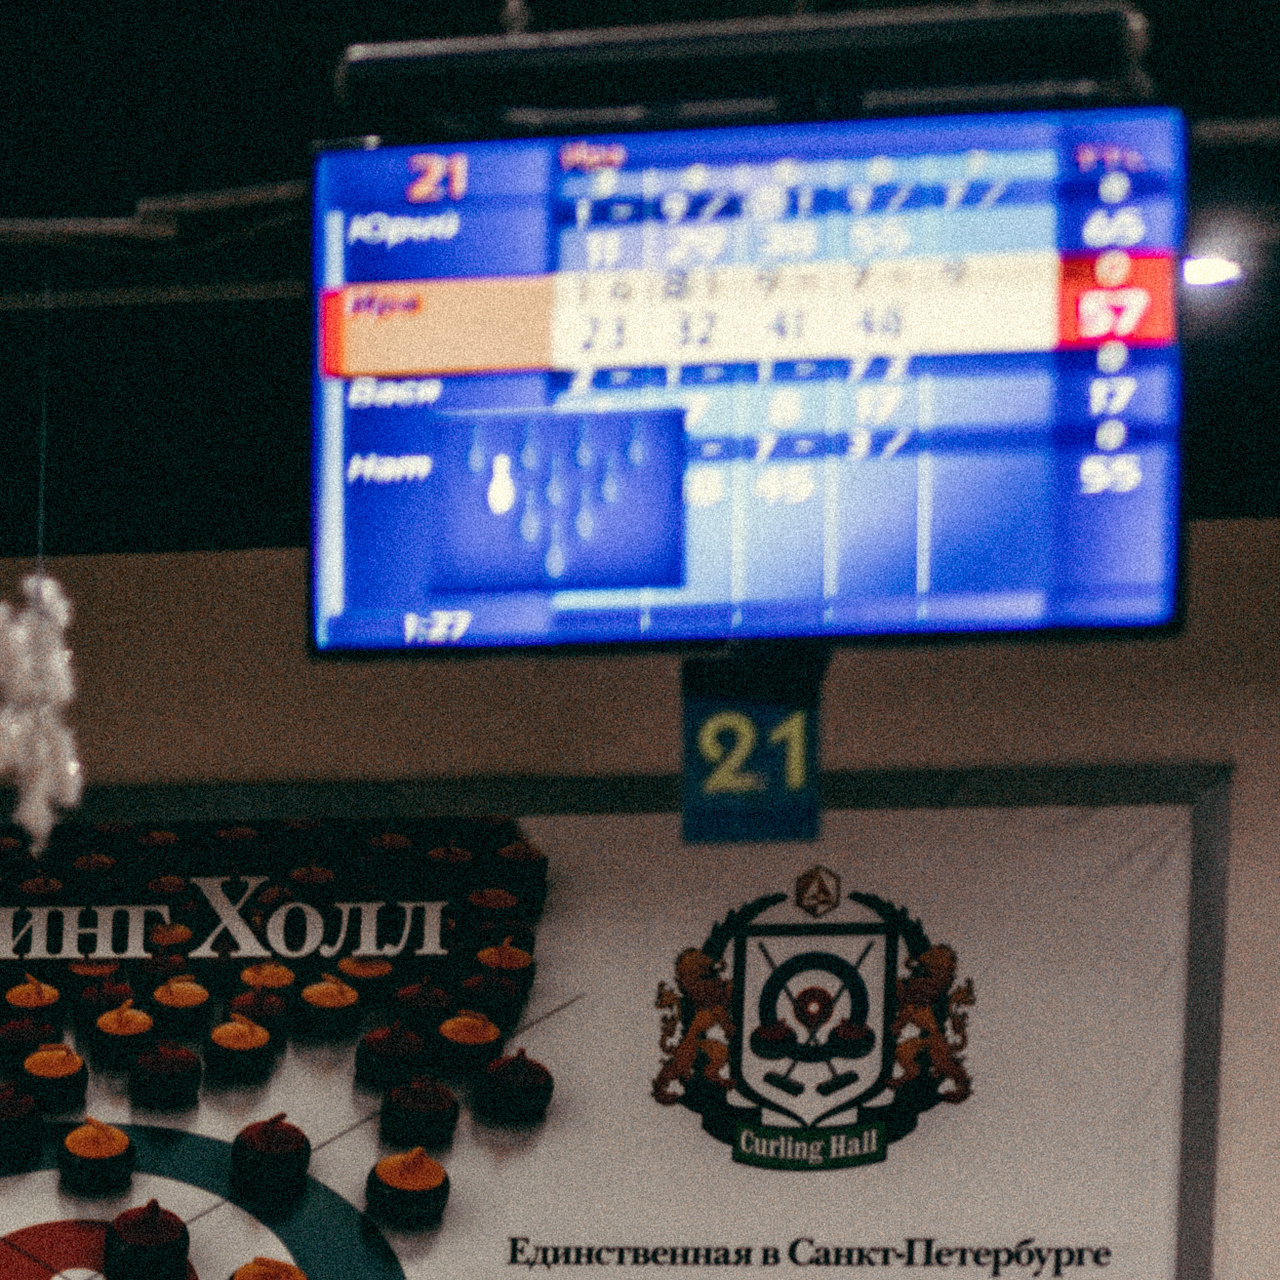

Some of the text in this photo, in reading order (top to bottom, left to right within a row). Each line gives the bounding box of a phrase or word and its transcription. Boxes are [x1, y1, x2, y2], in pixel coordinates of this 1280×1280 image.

[404, 152, 468, 203] 21
[697, 711, 808, 795] 21
[188, 874, 450, 959] Холл
[740, 1128, 879, 1164] Curling Hall
[507, 1237, 1112, 1278] Единственная в Санкт-Петербурге
